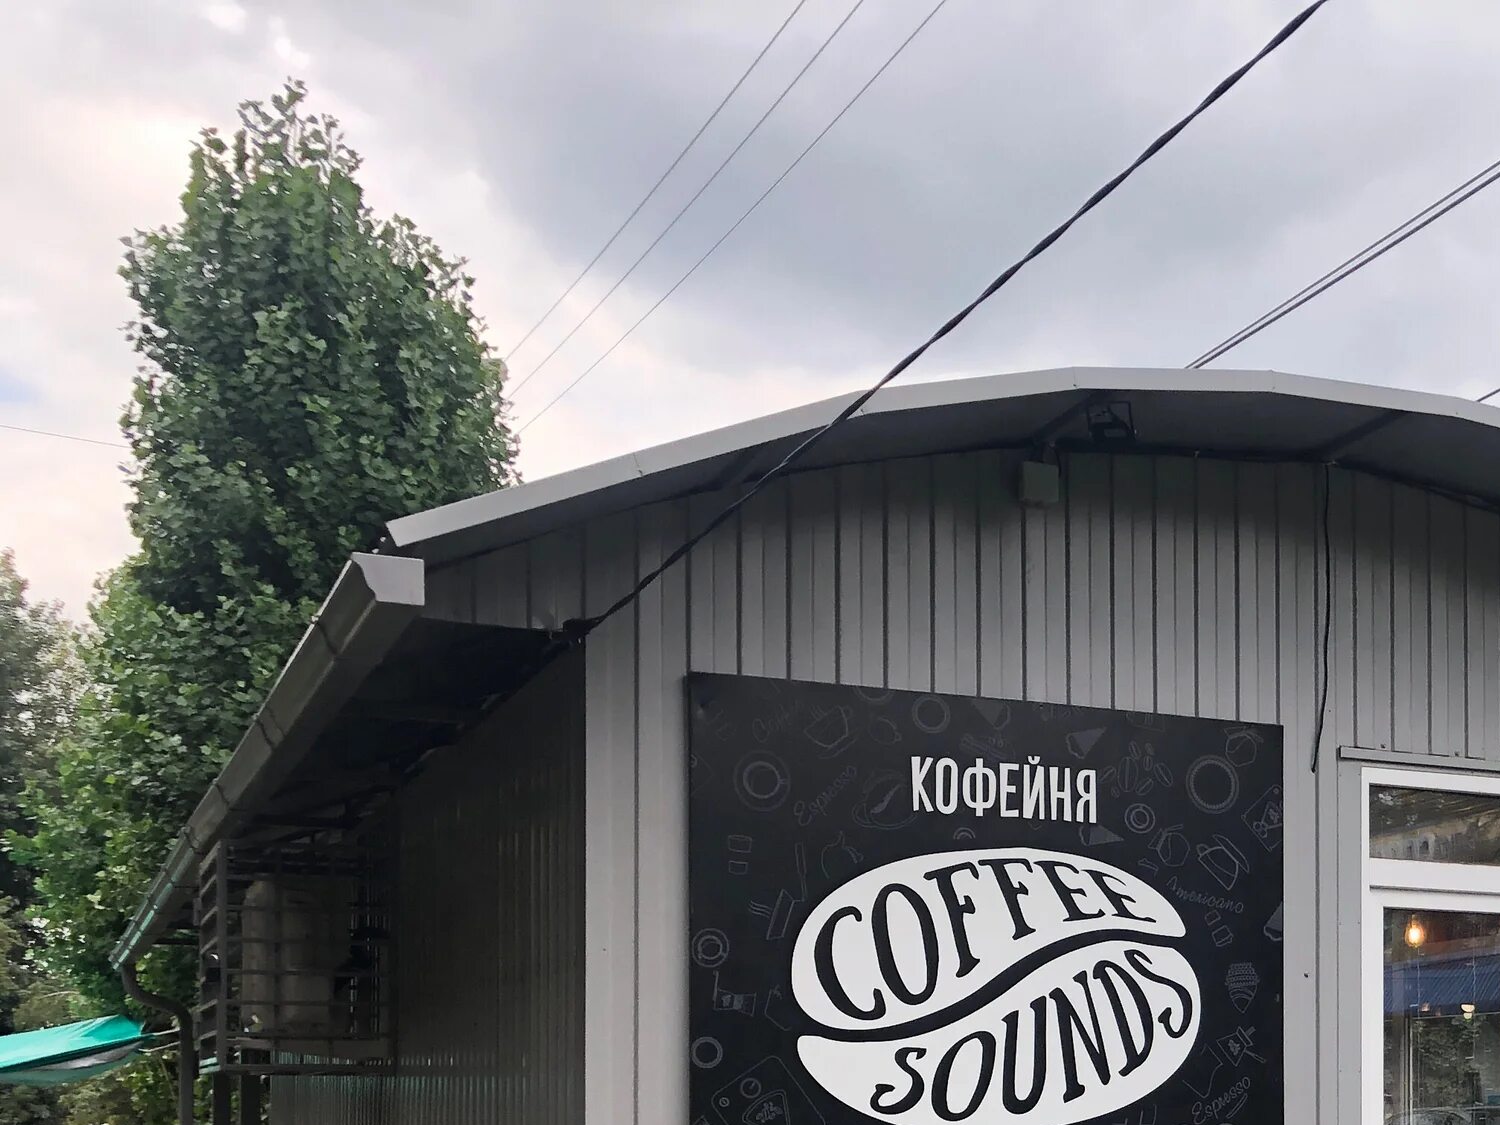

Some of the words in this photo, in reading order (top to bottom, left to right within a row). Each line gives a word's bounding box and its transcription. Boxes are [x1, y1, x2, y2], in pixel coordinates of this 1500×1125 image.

[911, 756, 1097, 823] КОФЕЙНЯ
[1165, 875, 1245, 915] Americano
[814, 858, 1156, 1020] COFFEE
[870, 949, 1193, 1122] SOUNDS
[1192, 1076, 1252, 1125] Espresso
